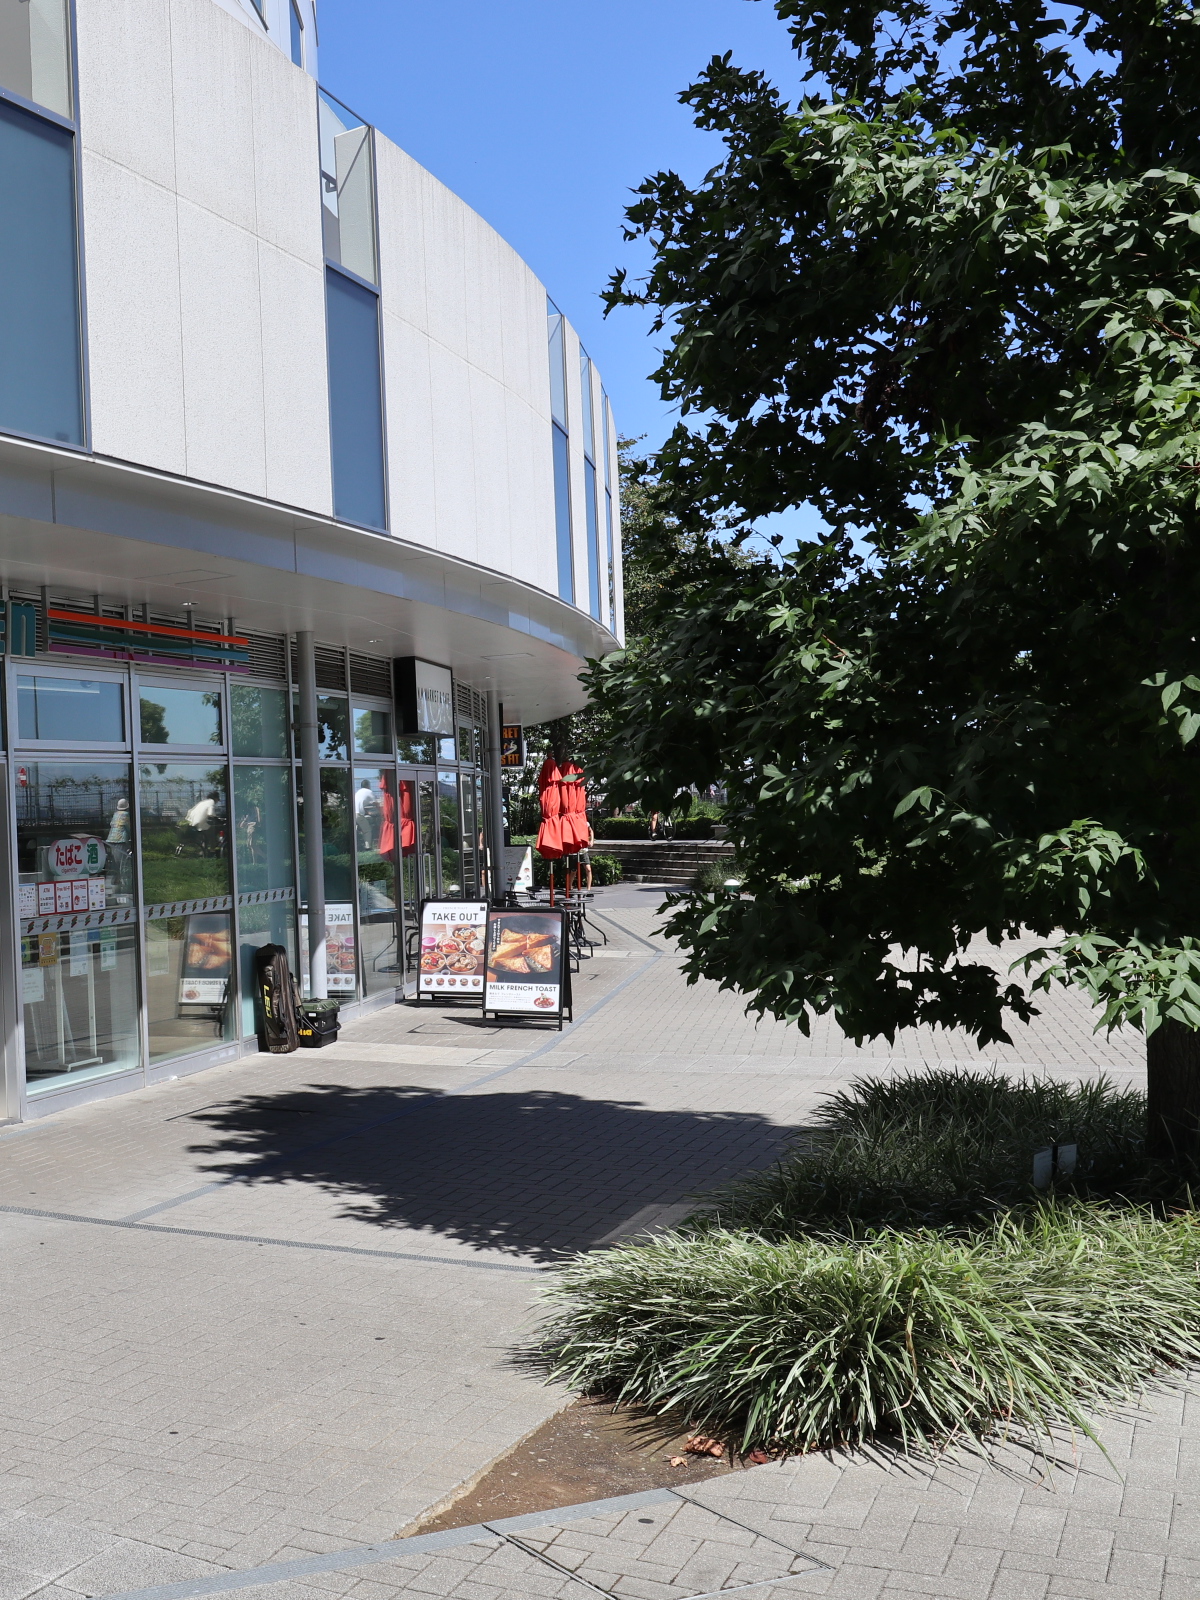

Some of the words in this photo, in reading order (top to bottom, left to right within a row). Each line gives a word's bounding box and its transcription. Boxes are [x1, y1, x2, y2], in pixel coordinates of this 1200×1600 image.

[55, 844, 83, 867] たばこ
[87, 843, 99, 864] 酒
[432, 912, 456, 921] TAKE
[459, 912, 479, 921] OUT
